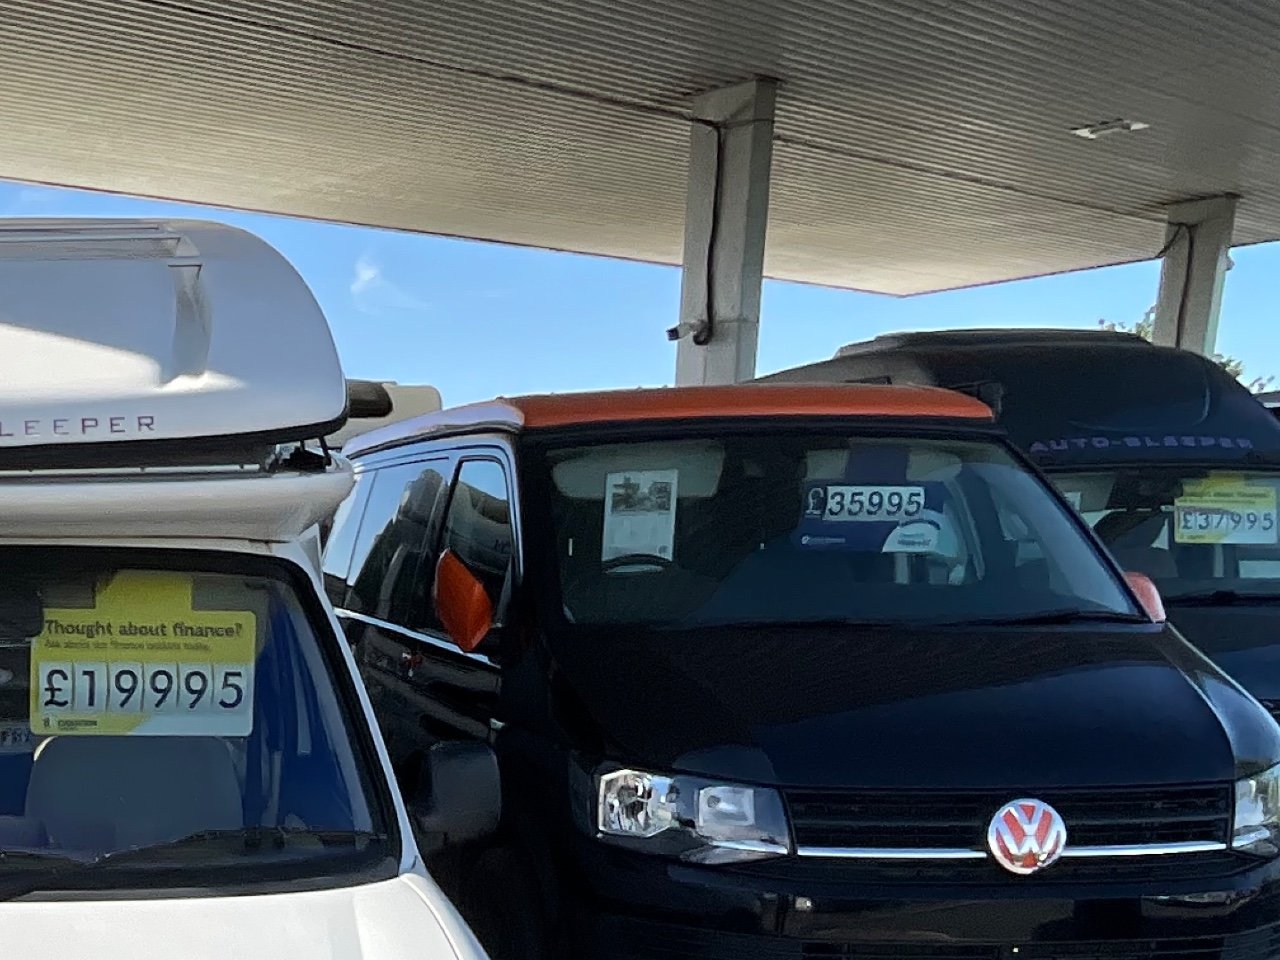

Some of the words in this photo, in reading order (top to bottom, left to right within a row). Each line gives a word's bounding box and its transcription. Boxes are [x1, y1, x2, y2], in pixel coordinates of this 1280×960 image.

[804, 486, 922, 517] £35995
[1182, 511, 1274, 531] £37995
[45, 619, 113, 639] Thought
[119, 621, 167, 636] about
[172, 622, 243, 638] finance?
[44, 668, 244, 710] £19995
